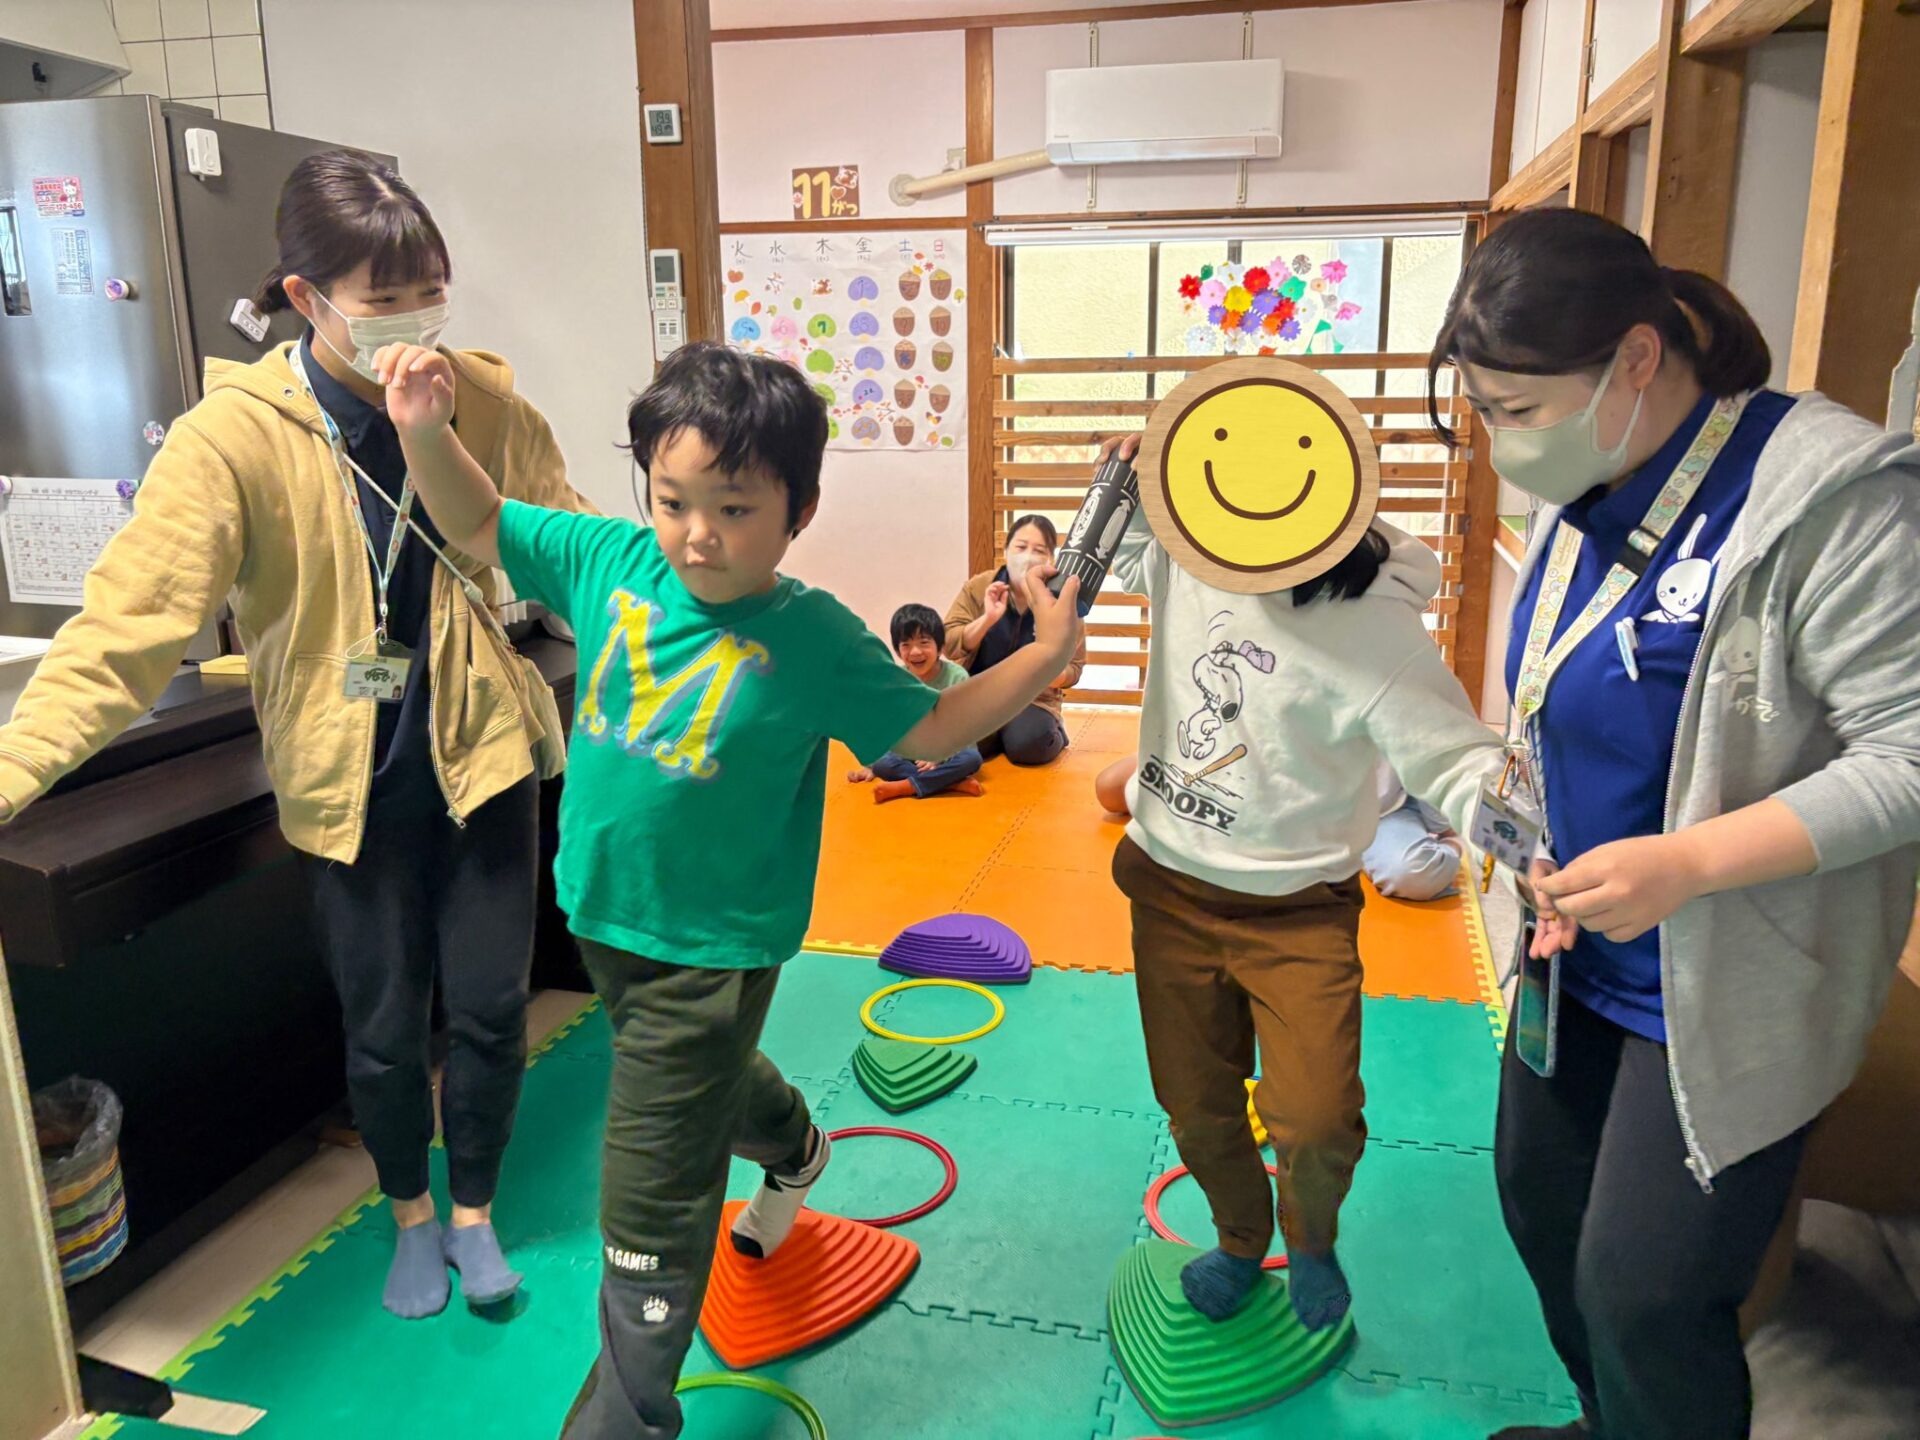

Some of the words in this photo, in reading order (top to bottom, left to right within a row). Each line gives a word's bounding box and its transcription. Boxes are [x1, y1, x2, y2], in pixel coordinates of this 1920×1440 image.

[731, 239, 753, 258] 火
[769, 240, 787, 256] 水
[816, 238, 834, 254] 木
[856, 236, 873, 253] 金
[899, 239, 913, 252] 土
[934, 239, 944, 252] 日
[817, 321, 826, 334] 7
[577, 588, 770, 780] M
[614, 1248, 660, 1271] GAMES
